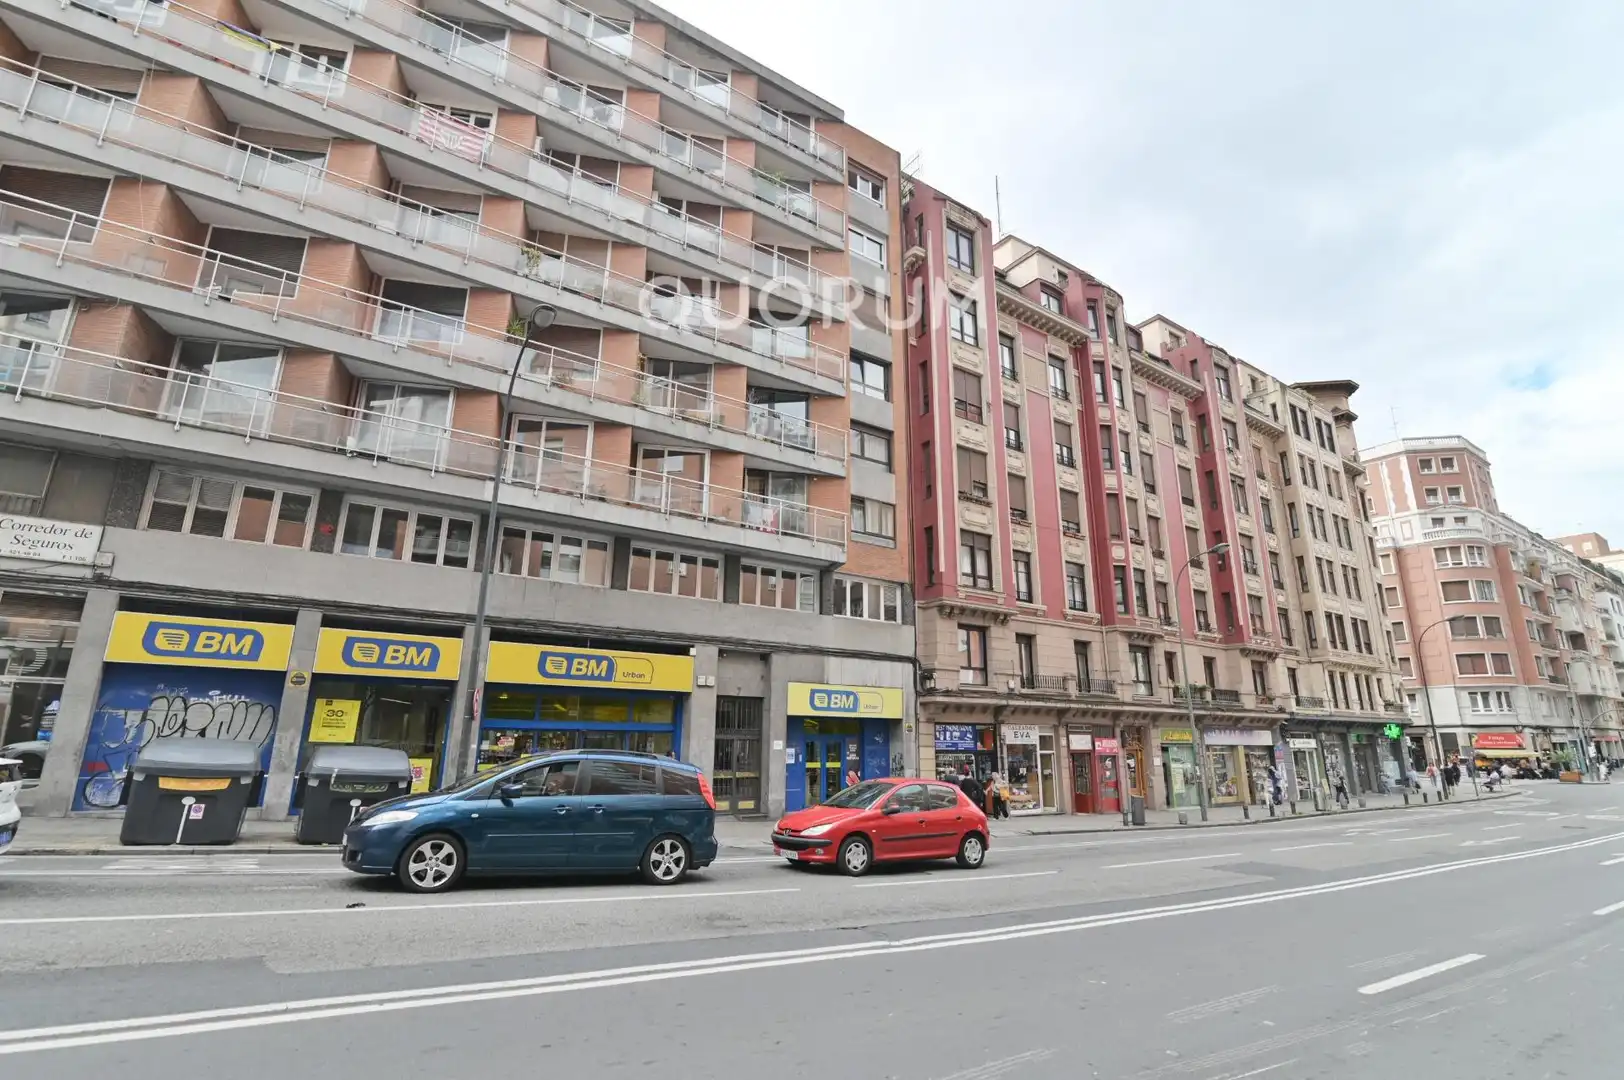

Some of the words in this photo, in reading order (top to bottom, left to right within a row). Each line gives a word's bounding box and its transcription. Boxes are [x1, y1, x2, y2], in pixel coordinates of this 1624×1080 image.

[0, 518, 71, 536] Corredor
[74, 528, 93, 539] de
[10, 534, 74, 550] Seguros
[194, 631, 255, 655] BM
[384, 645, 432, 667] BM
[570, 658, 608, 677] BM
[622, 671, 646, 679] Urban
[830, 693, 854, 709] BM
